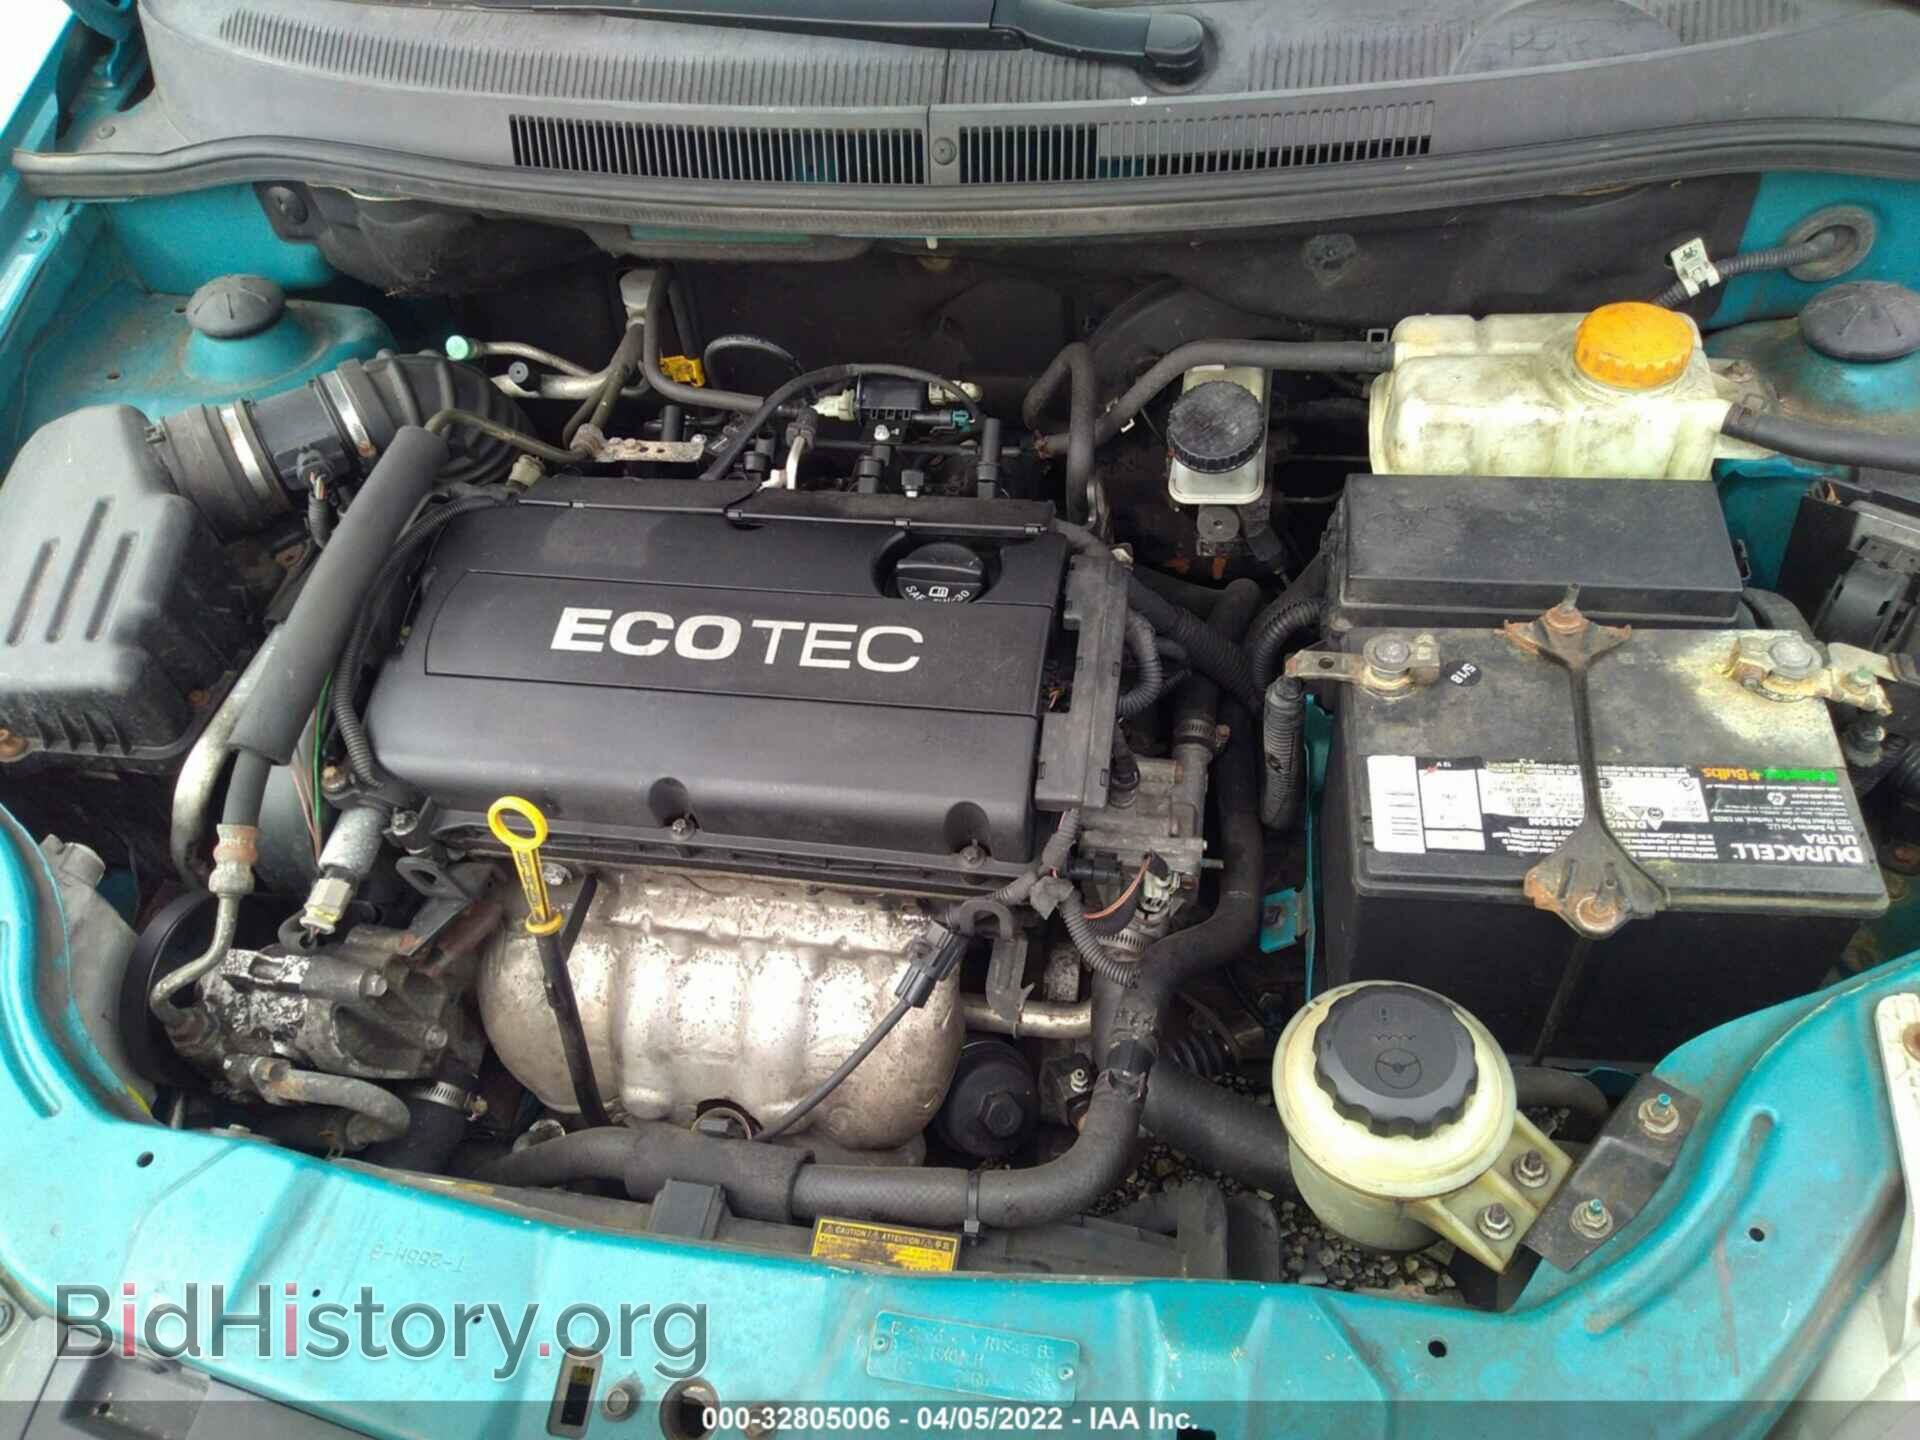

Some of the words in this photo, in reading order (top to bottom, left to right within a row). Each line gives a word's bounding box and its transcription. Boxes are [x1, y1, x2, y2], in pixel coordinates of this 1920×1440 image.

[550, 607, 924, 673] ECOTEC
[1450, 662, 1477, 684] 5/18
[1802, 833, 1858, 845] ULTRA
[1730, 842, 1865, 863] DURACELL
